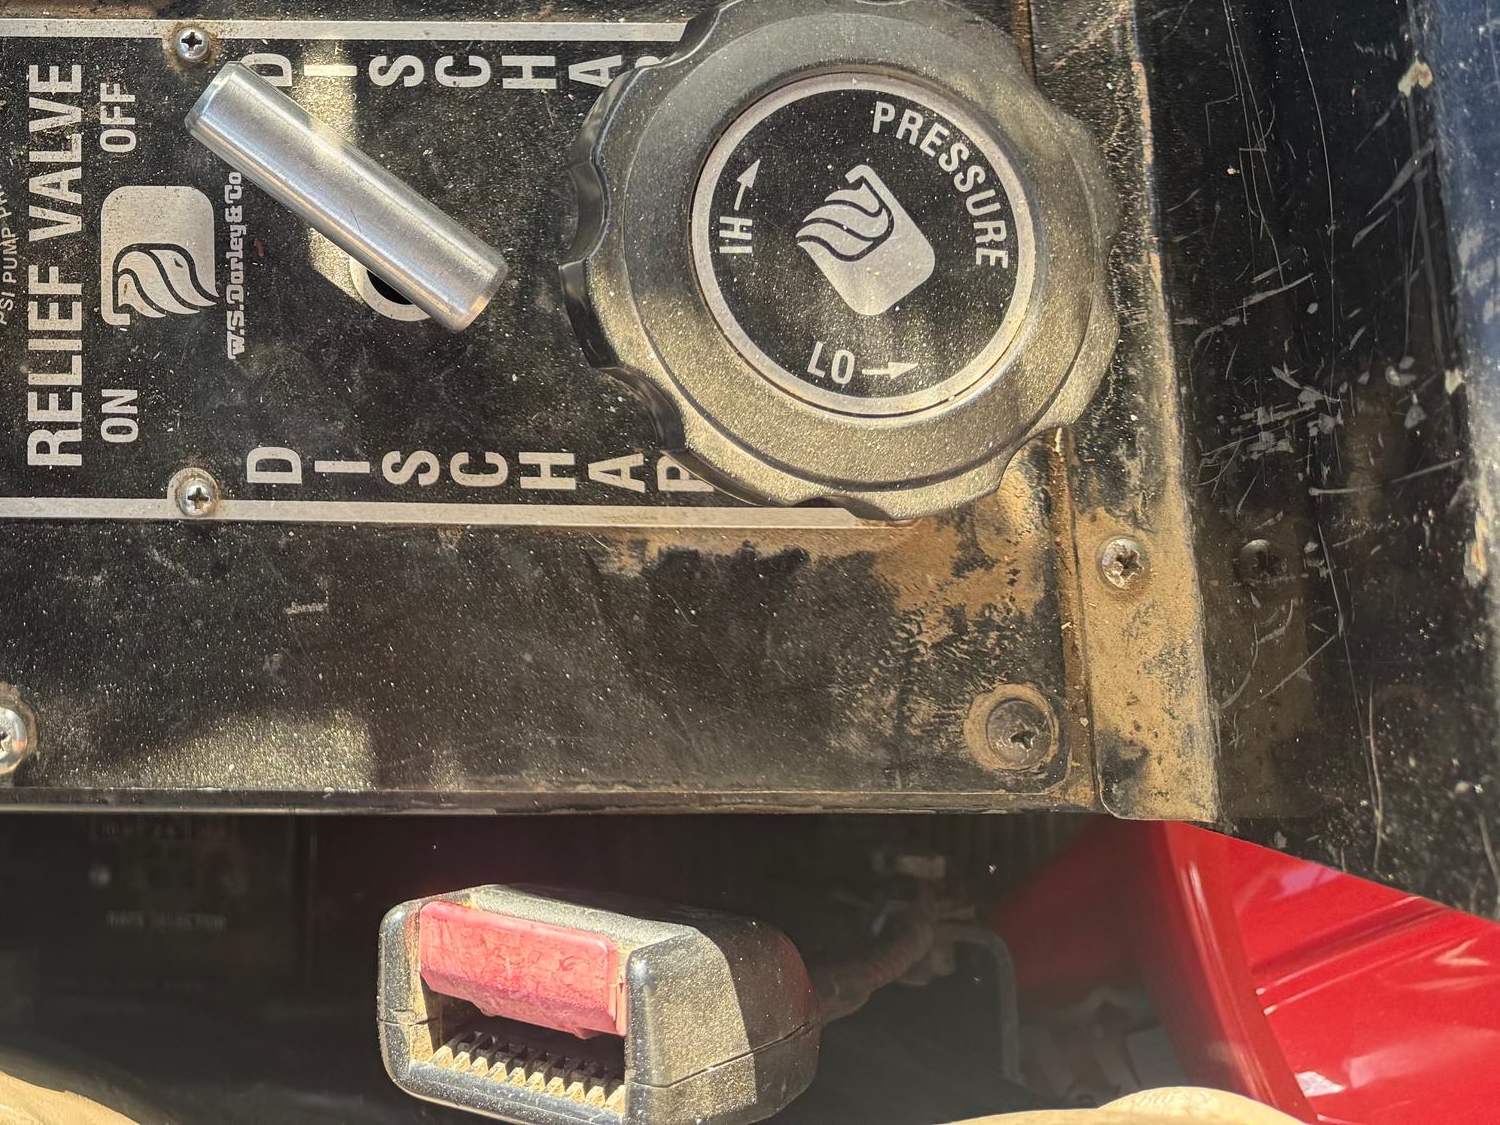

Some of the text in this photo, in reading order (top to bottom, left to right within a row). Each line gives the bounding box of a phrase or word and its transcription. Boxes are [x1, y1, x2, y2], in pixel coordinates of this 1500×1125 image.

[240, 53, 666, 90] DISCHA
[100, 81, 137, 154] OFF
[871, 100, 1009, 270] PRESSURE
[1, 227, 19, 283] PUMP
[719, 215, 753, 255] HI
[27, 63, 83, 467] RELIEF VALVE
[807, 340, 856, 386] LO
[100, 388, 139, 444] ON
